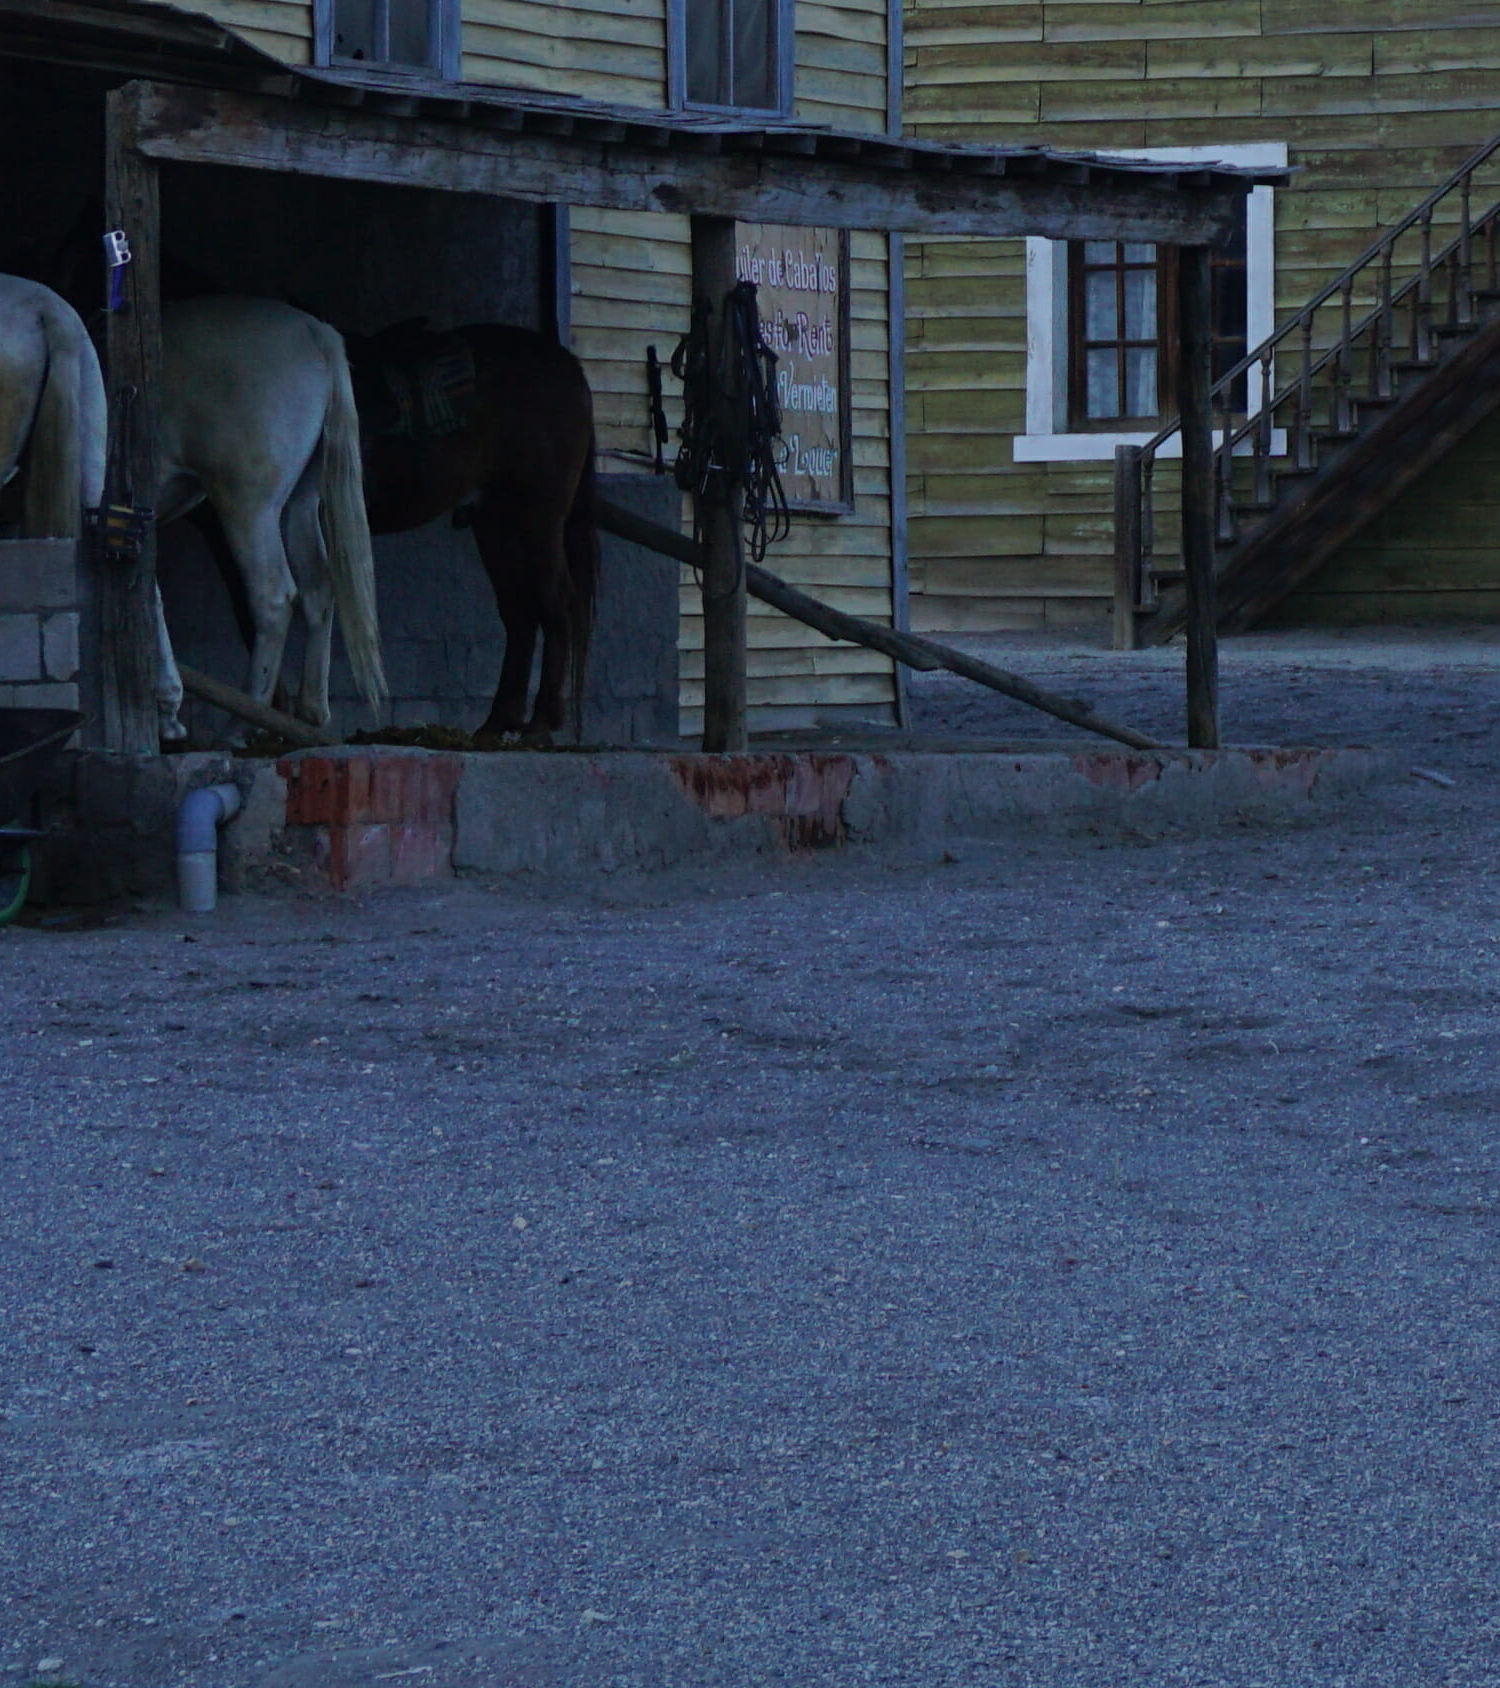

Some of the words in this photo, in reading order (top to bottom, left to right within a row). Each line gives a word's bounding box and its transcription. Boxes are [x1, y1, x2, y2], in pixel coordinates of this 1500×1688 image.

[768, 247, 783, 288] de
[784, 248, 837, 293] Caballos
[795, 310, 835, 362] Rent
[779, 360, 838, 413] Vermieten
[788, 433, 838, 477] Louer
